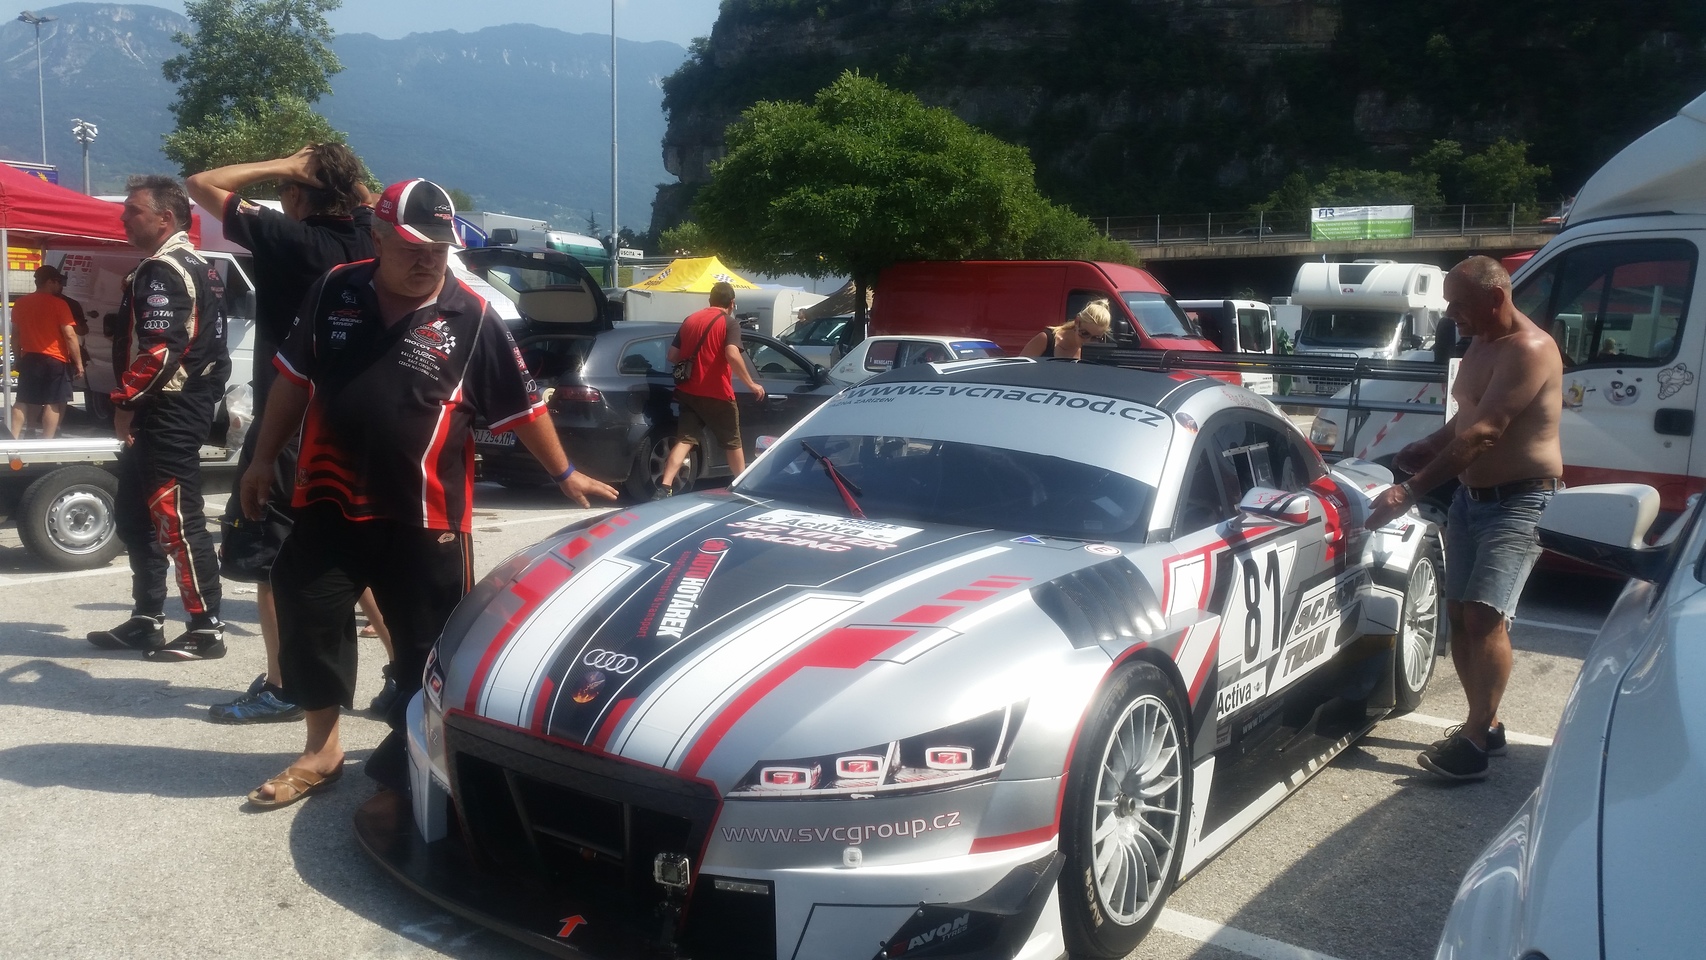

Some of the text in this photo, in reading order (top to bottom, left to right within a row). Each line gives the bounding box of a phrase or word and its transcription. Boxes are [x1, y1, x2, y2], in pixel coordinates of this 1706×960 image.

[847, 385, 1166, 428] www.svcnachod.cz
[729, 530, 853, 552] RACING
[776, 517, 865, 536] Activa
[1243, 549, 1281, 665] 81
[1283, 626, 1332, 678] TEAM
[1217, 683, 1252, 715] Activa
[721, 811, 962, 846] www.svcgroup.cz
[907, 912, 970, 951] AVON
[941, 924, 968, 942] TYRES
